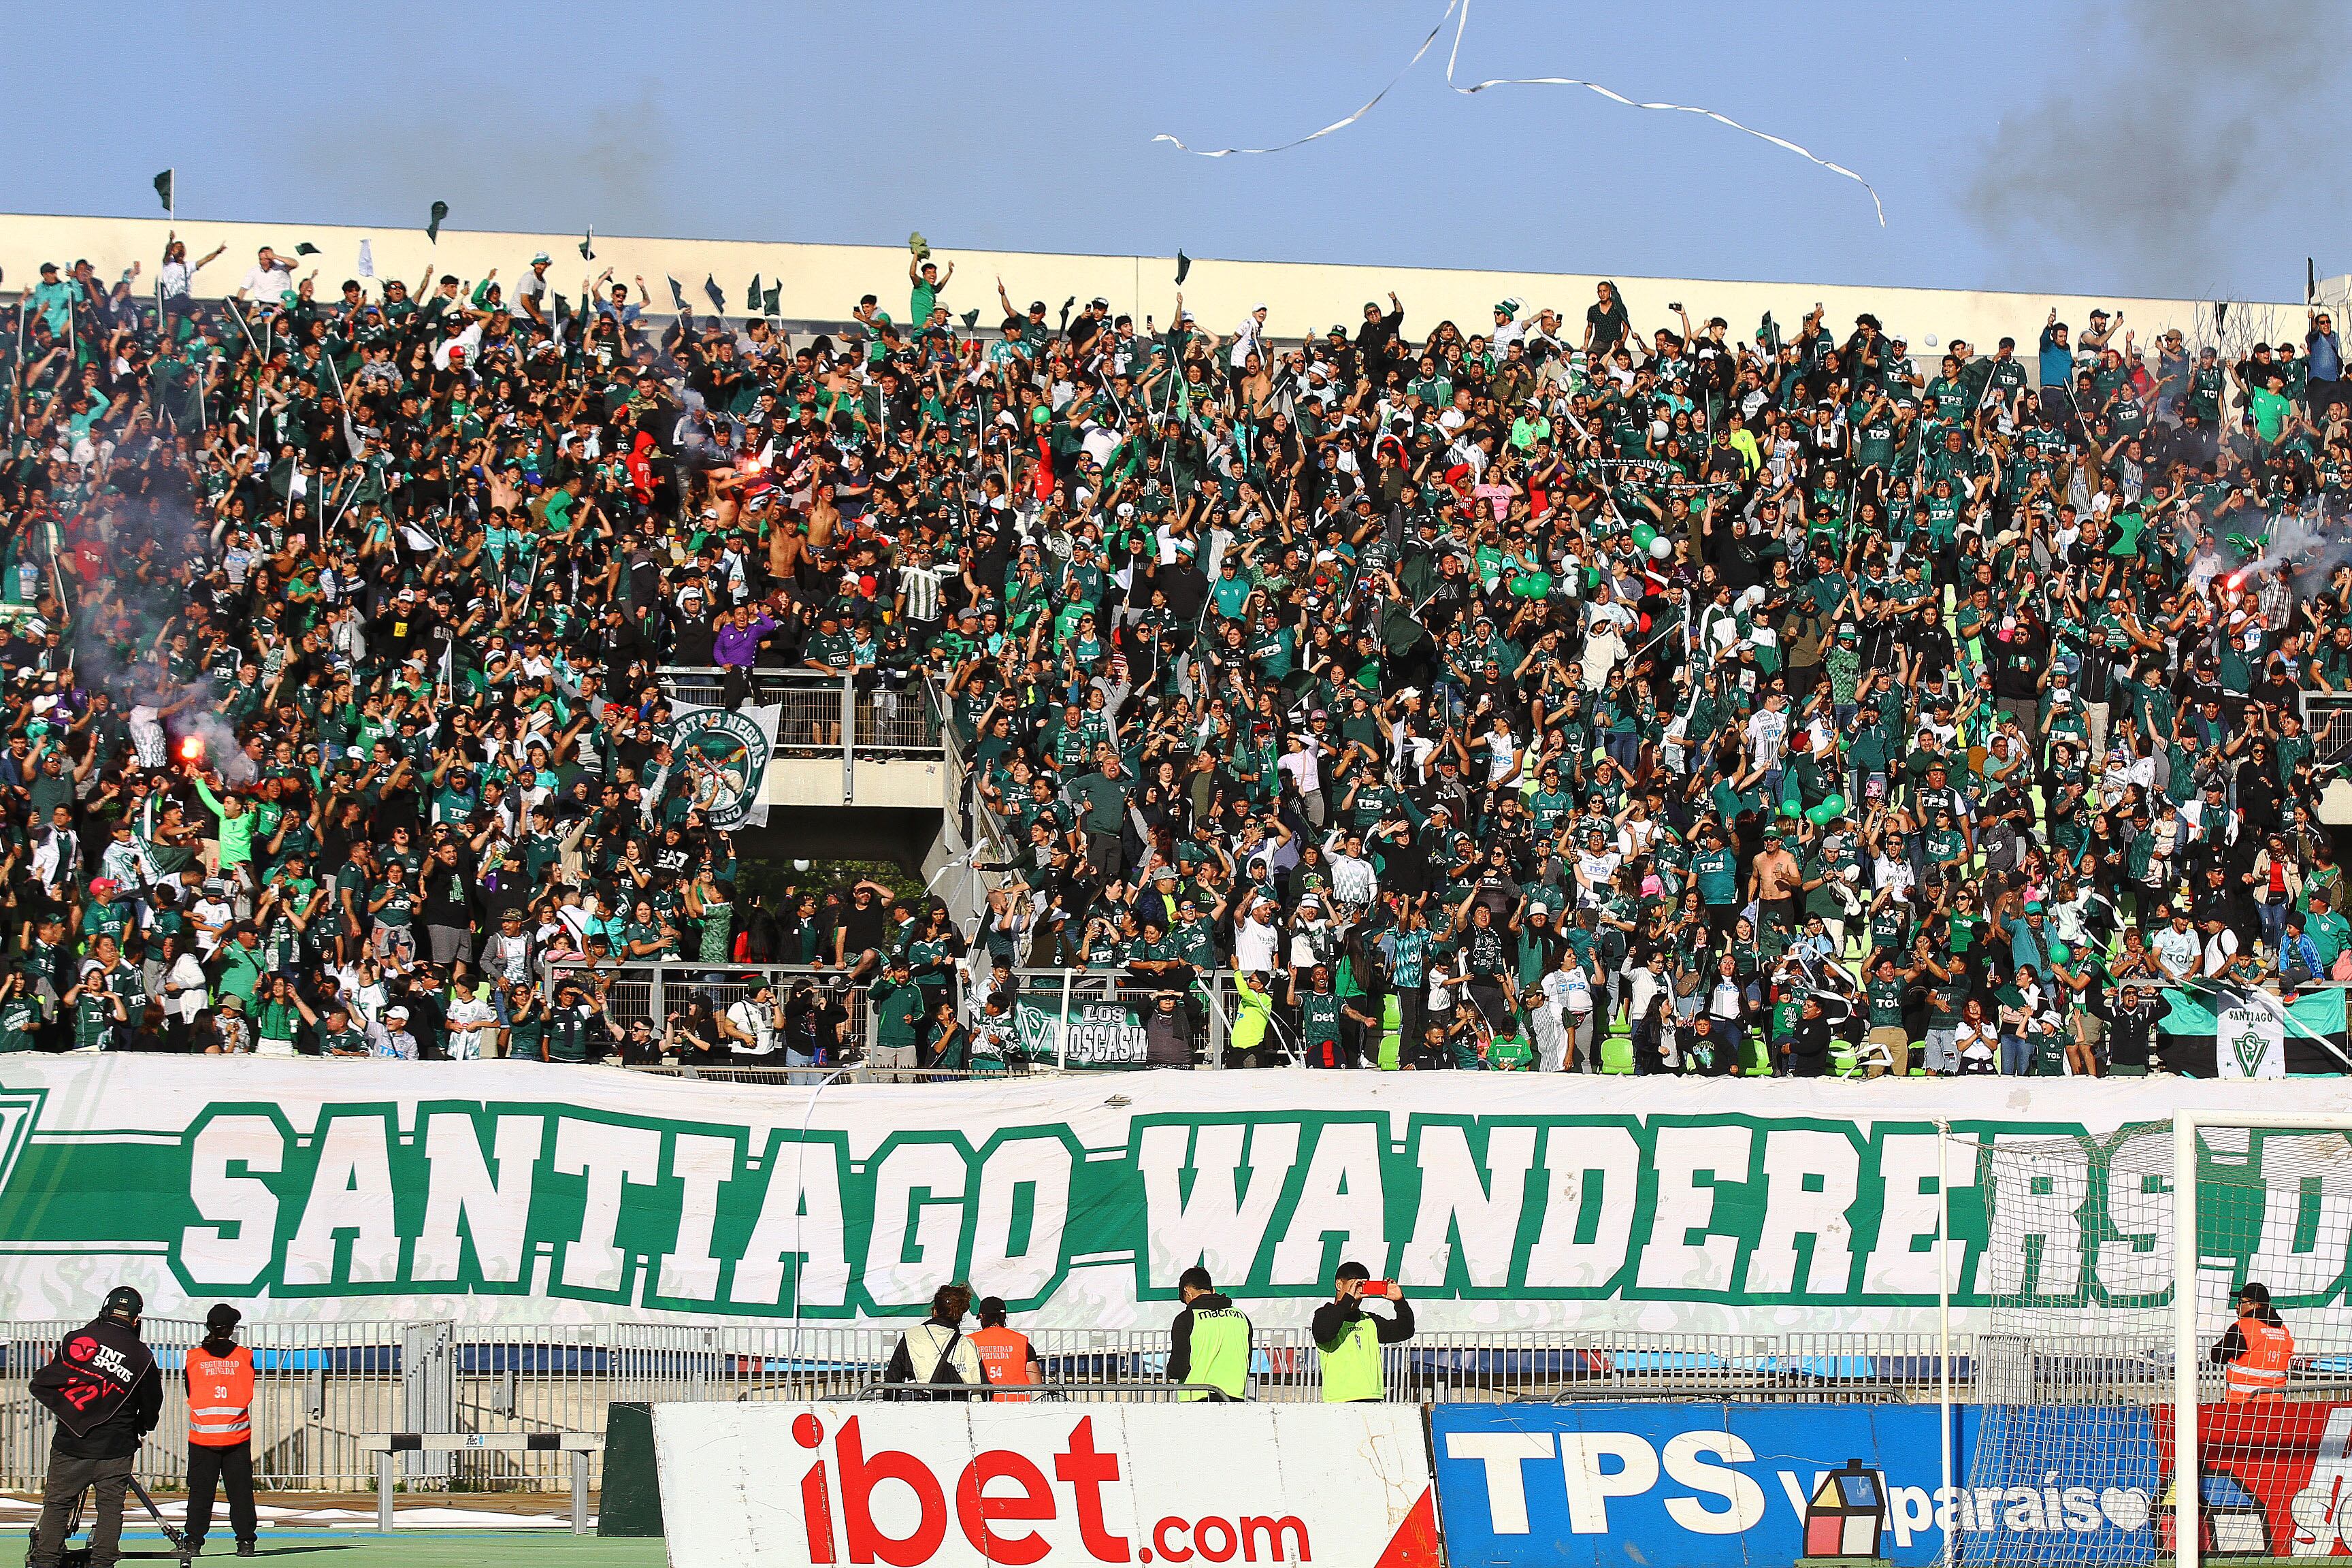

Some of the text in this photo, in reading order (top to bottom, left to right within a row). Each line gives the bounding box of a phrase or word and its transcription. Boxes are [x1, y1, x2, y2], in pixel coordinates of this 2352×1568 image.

[2000, 374, 2018, 384] TPS
[1940, 395, 1963, 404] TPS
[2117, 409, 2138, 419] TPS
[1869, 429, 1890, 438] TPS
[1365, 558, 1384, 567] TCL
[831, 655, 847, 663] TCL
[1358, 798, 1383, 808] TPS
[1927, 840, 1950, 852] TPS
[1838, 849, 1856, 858] PS
[1588, 864, 1607, 873] TPS
[1699, 862, 1724, 870] TPS
[1876, 925, 1896, 933] TPS
[1090, 951, 1113, 960] TPS
[1557, 982, 1586, 992] TPS
[1083, 1005, 1126, 1023] LOS
[1313, 1011, 1335, 1022] ibet
[2229, 1010, 2273, 1022] SANTIAGO
[557, 1020, 583, 1029] TS
[174, 1107, 1079, 1313] SANTIAGO
[1134, 1120, 2181, 1298] WANDERERS
[99, 1344, 126, 1363] TNT
[92, 1355, 134, 1383] SPORTS
[200, 1360, 240, 1369] SEGURIDAD
[206, 1368, 235, 1376] PRIVADA
[990, 1366, 1002, 1378] 54
[214, 1386, 227, 1399] 30
[1446, 1431, 1765, 1536] TPS
[793, 1414, 1311, 1567] ibet.com
